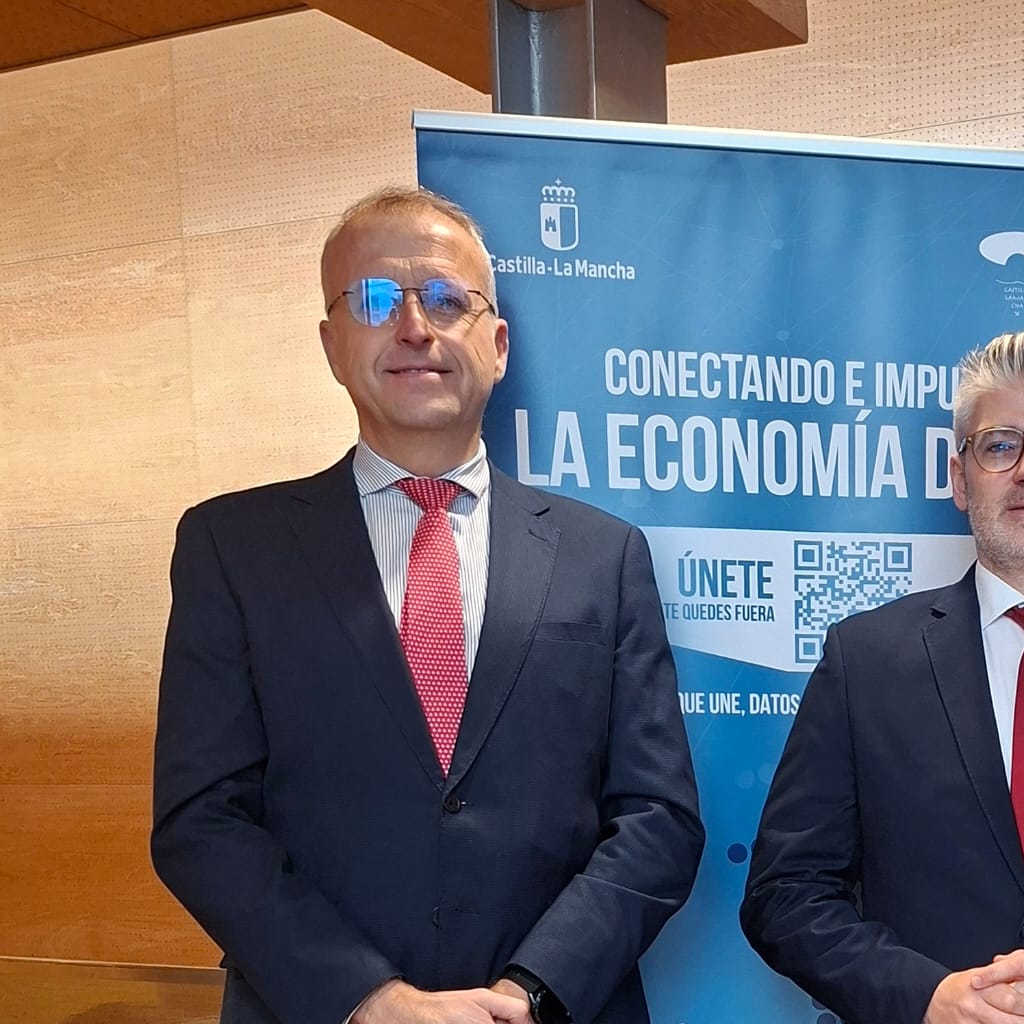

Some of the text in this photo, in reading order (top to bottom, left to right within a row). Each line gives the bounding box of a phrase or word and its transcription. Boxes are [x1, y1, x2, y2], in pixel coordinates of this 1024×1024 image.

[575, 259, 636, 280] Mancha
[605, 348, 835, 406] CONECTANDO
[845, 361, 865, 407] E
[515, 408, 591, 488] LA
[606, 410, 908, 499] ECONOMÍA
[678, 551, 774, 599] ÚNETE
[682, 603, 732, 621] QUEDES
[735, 604, 775, 622] FUERA
[709, 692, 746, 717] UNE,
[750, 693, 800, 715] DATOS
